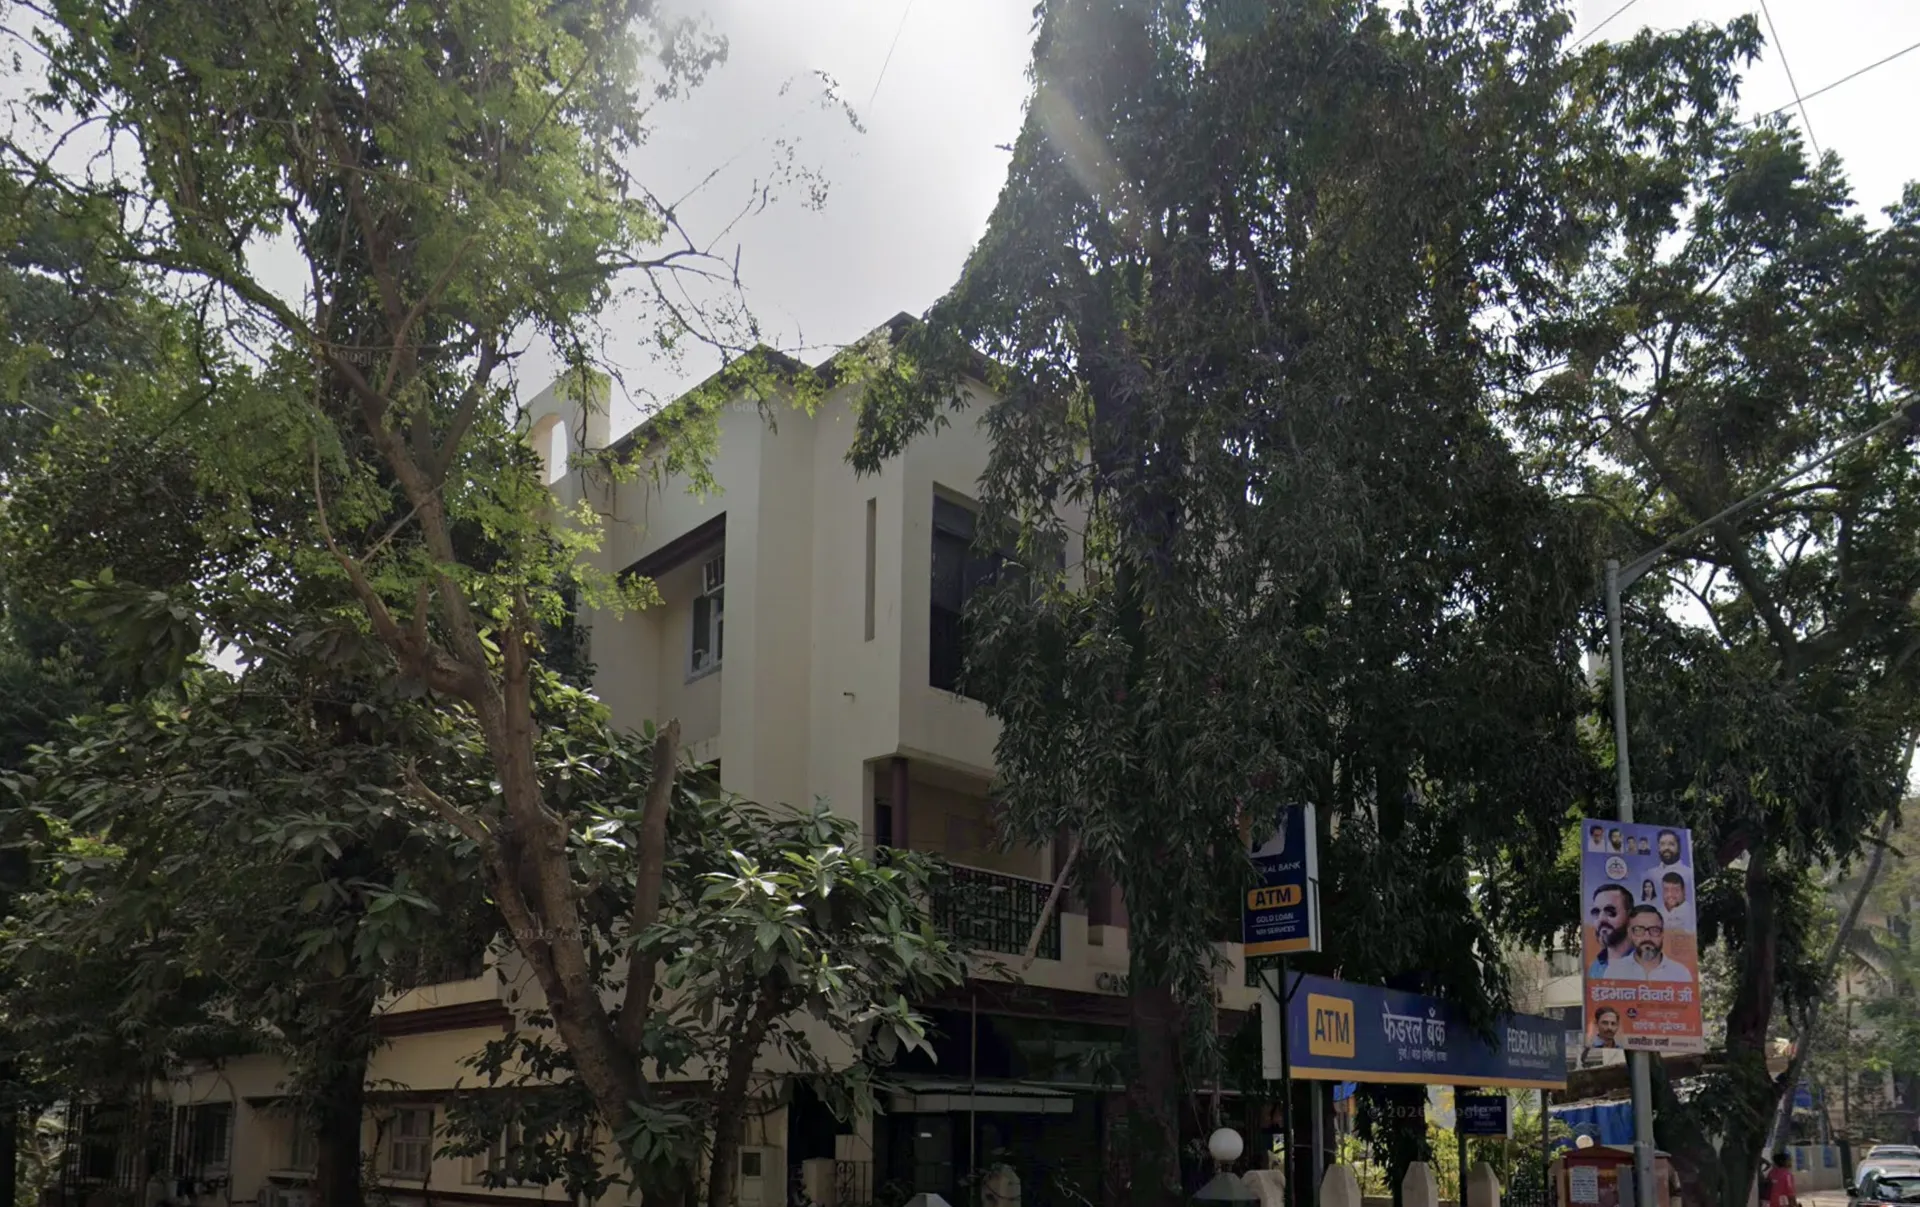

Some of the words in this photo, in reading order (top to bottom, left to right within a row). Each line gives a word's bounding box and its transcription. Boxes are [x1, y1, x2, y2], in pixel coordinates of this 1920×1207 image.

[1279, 862, 1300, 871] BANK
[1256, 888, 1291, 905] ATM
[1256, 914, 1275, 924] GOLD
[1275, 912, 1294, 922] LOAN
[1639, 985, 1674, 1001] तिवारी
[1315, 1008, 1350, 1045] ATM
[1382, 1000, 1423, 1045] फेडरल
[1507, 1027, 1537, 1056] FEDERAL
[1538, 1033, 1558, 1056] BANK
